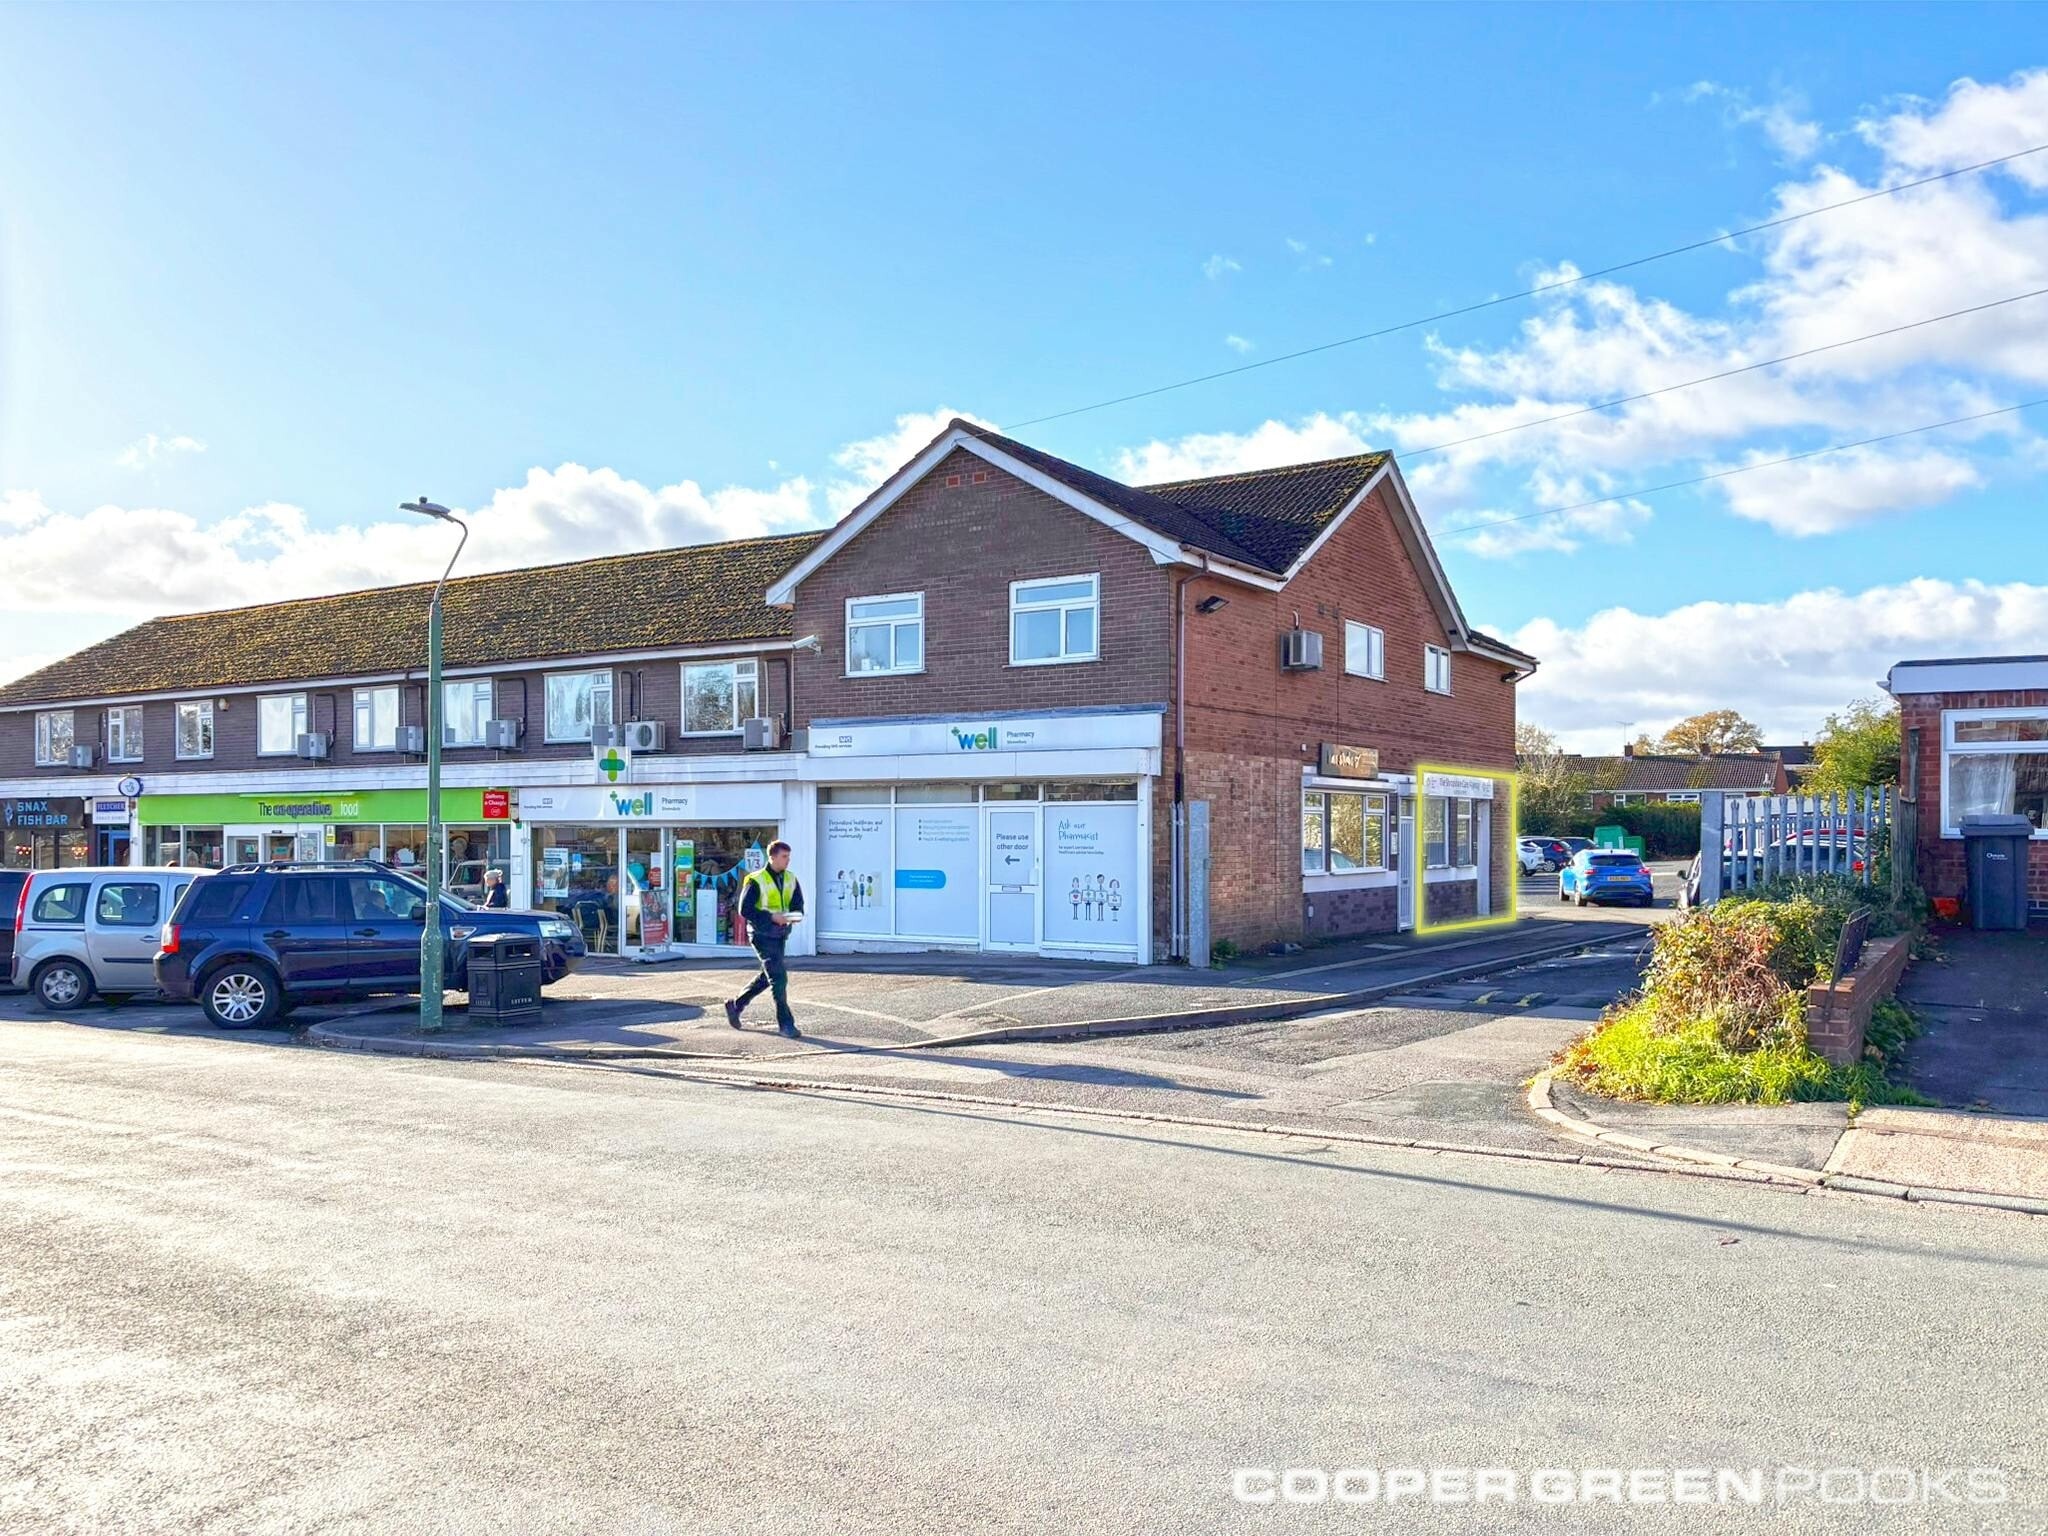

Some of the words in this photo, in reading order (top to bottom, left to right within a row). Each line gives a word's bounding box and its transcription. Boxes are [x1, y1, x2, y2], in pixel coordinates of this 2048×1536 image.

[957, 727, 997, 750] well
[1006, 731, 1035, 739] Pharmacy
[17, 801, 48, 812] SNAX
[258, 802, 272, 816] The
[615, 792, 652, 816] well
[17, 815, 44, 825] FISH
[45, 814, 68, 825] BAR
[996, 842, 1013, 850] other
